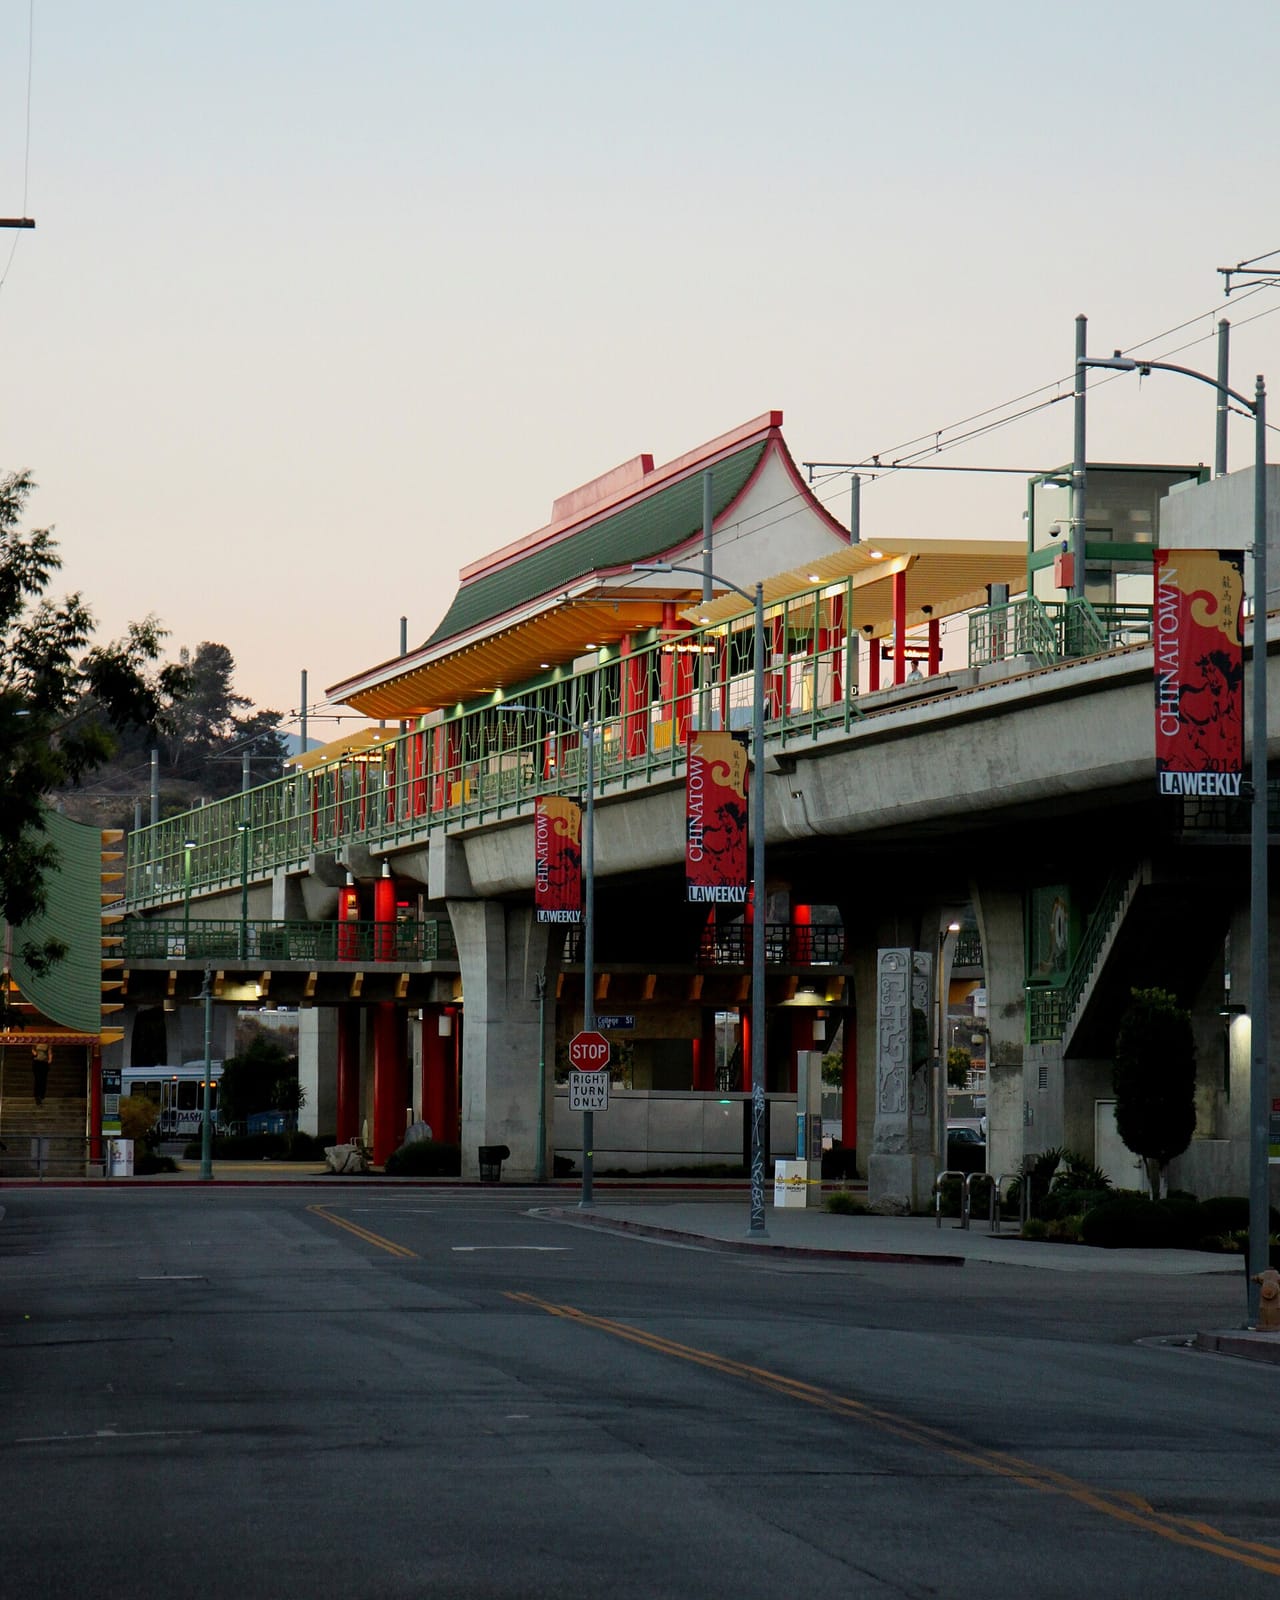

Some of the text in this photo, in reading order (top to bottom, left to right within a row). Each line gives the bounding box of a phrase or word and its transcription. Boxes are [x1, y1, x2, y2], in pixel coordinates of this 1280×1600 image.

[1158, 567, 1181, 737] CHINATOWN
[1201, 757, 1239, 771] 2014
[689, 743, 704, 862] CHINATOWN
[537, 804, 549, 893] CHINATOWN
[572, 1044, 606, 1060] STOP
[573, 1075, 606, 1084] RIGHT
[573, 1086, 605, 1095] TURN
[573, 1098, 604, 1107] ONLY
[177, 1112, 202, 1121] DASH
